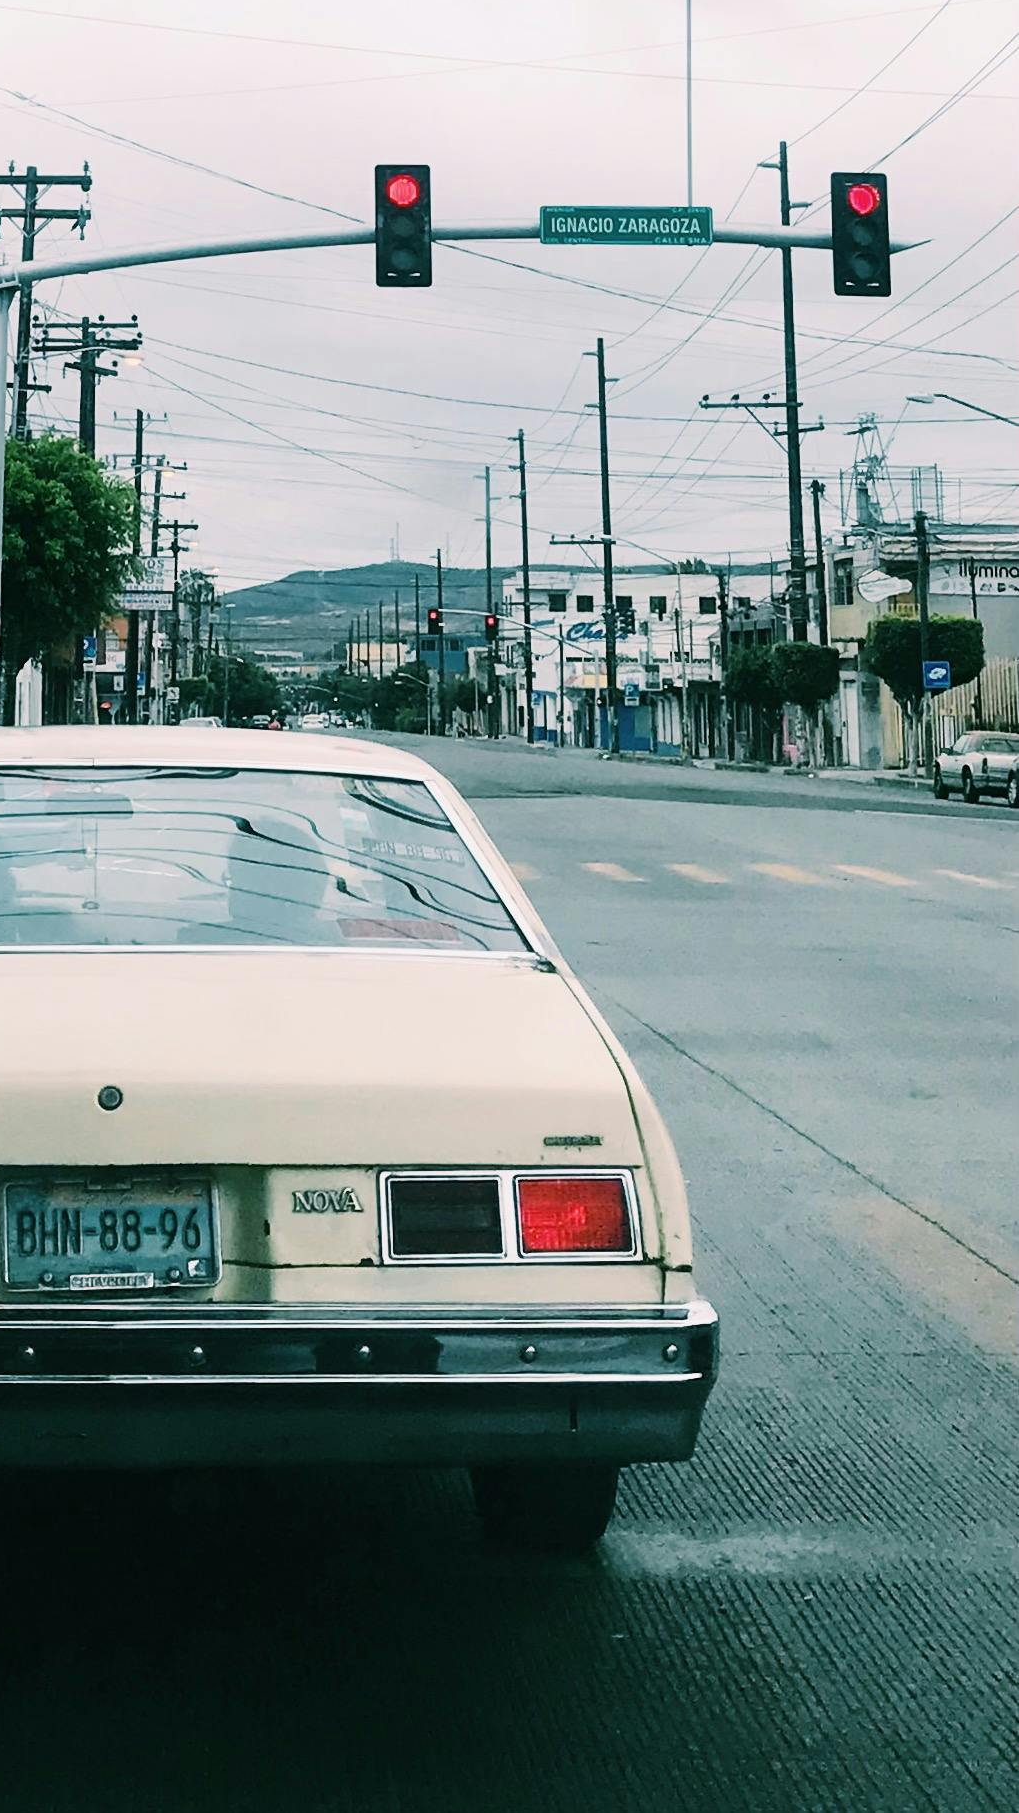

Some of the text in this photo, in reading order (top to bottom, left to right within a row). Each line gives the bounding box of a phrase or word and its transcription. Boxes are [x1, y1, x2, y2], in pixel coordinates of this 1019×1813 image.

[551, 217, 701, 234] IGNACIO ZARAGOZA
[291, 1187, 364, 1213] NOVA
[16, 1206, 201, 1258] BHN-88-96
[71, 1274, 150, 1288] CHEVROLET
